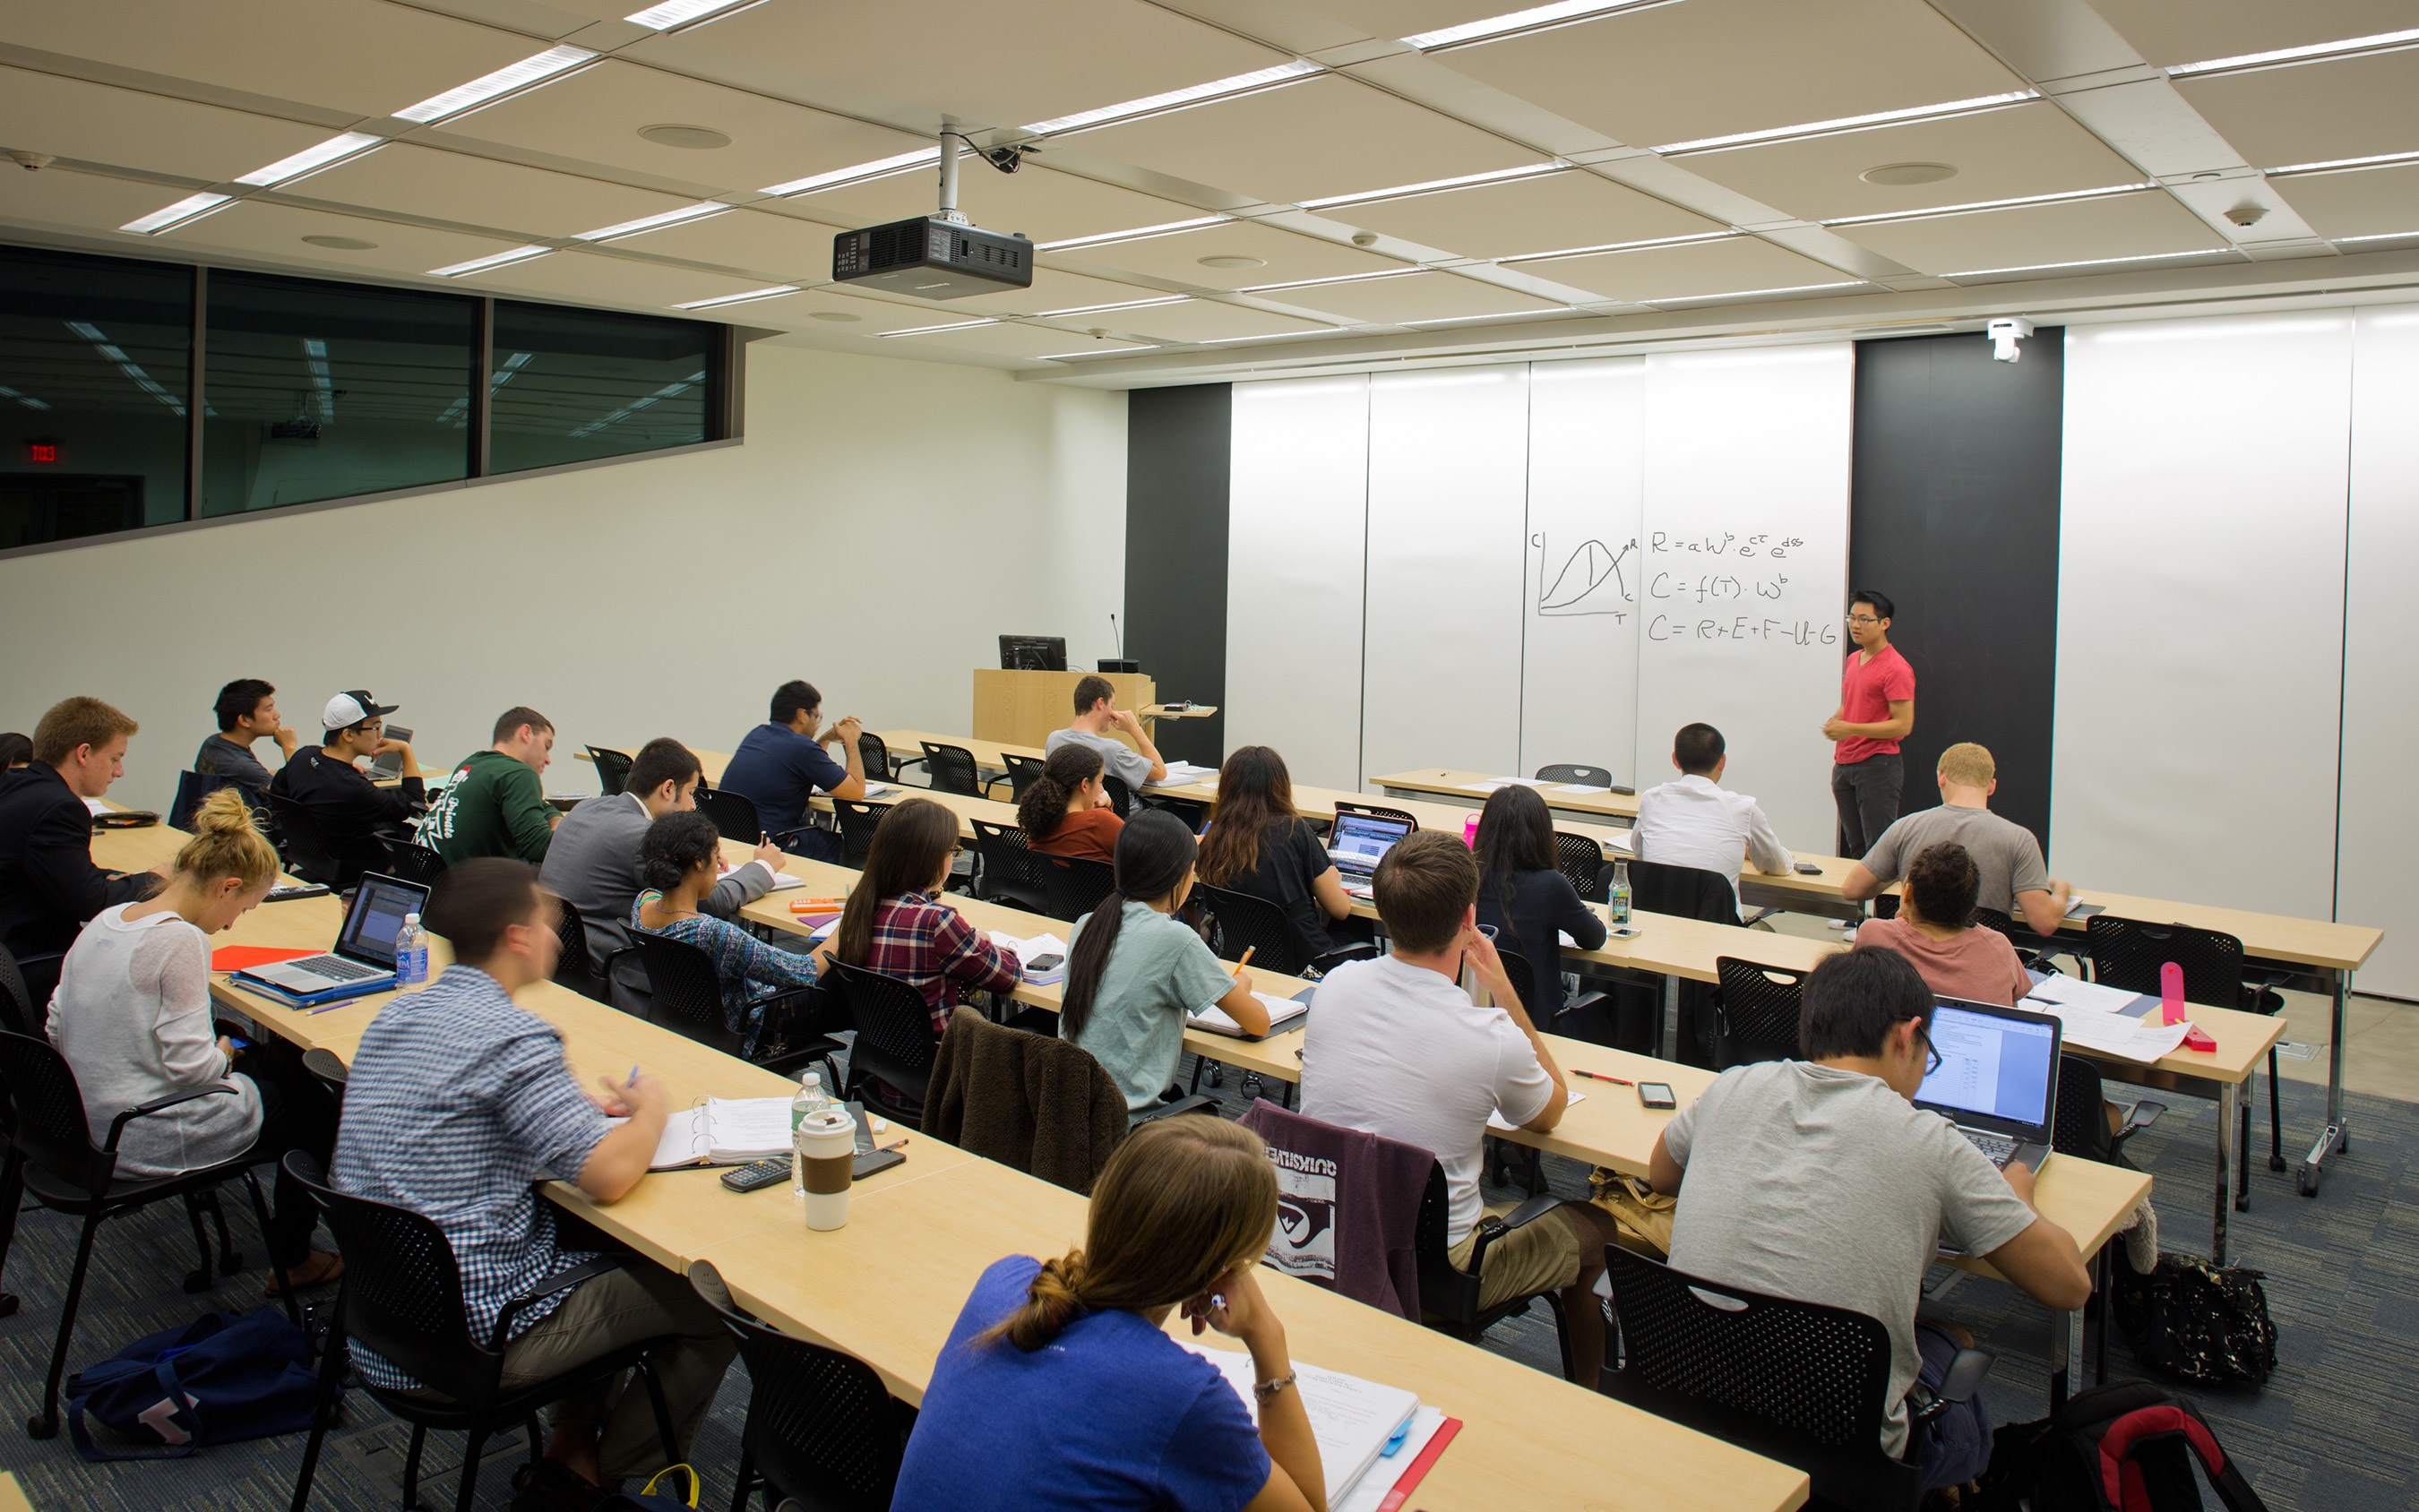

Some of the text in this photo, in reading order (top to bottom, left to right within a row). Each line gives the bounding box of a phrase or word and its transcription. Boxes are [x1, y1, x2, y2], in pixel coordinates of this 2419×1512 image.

[1630, 537, 1638, 549] R
[1652, 531, 1668, 553] R
[1614, 613, 1627, 624] T
